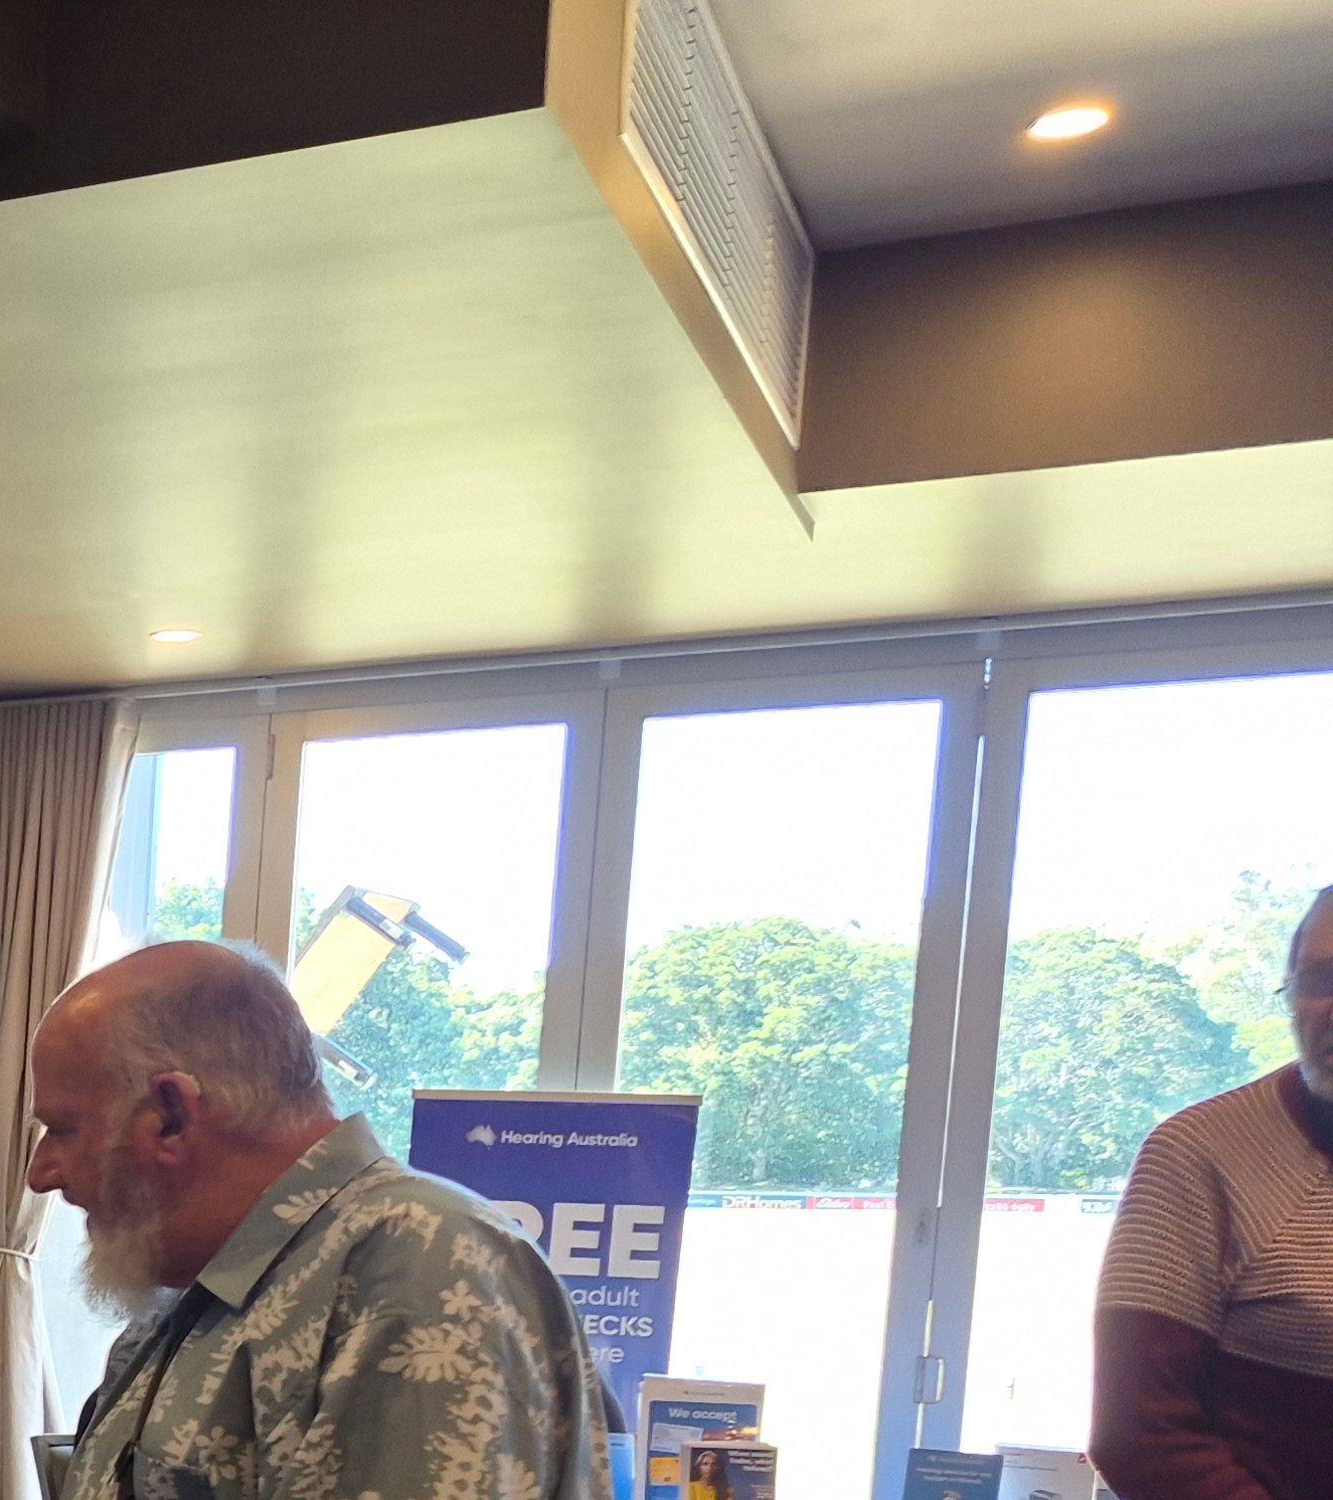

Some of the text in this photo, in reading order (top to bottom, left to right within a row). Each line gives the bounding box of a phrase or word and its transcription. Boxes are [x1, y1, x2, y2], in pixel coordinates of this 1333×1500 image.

[501, 1130, 638, 1148] Hearing Australia
[571, 1286, 640, 1308] adult
[668, 1407, 738, 1424] We accept
